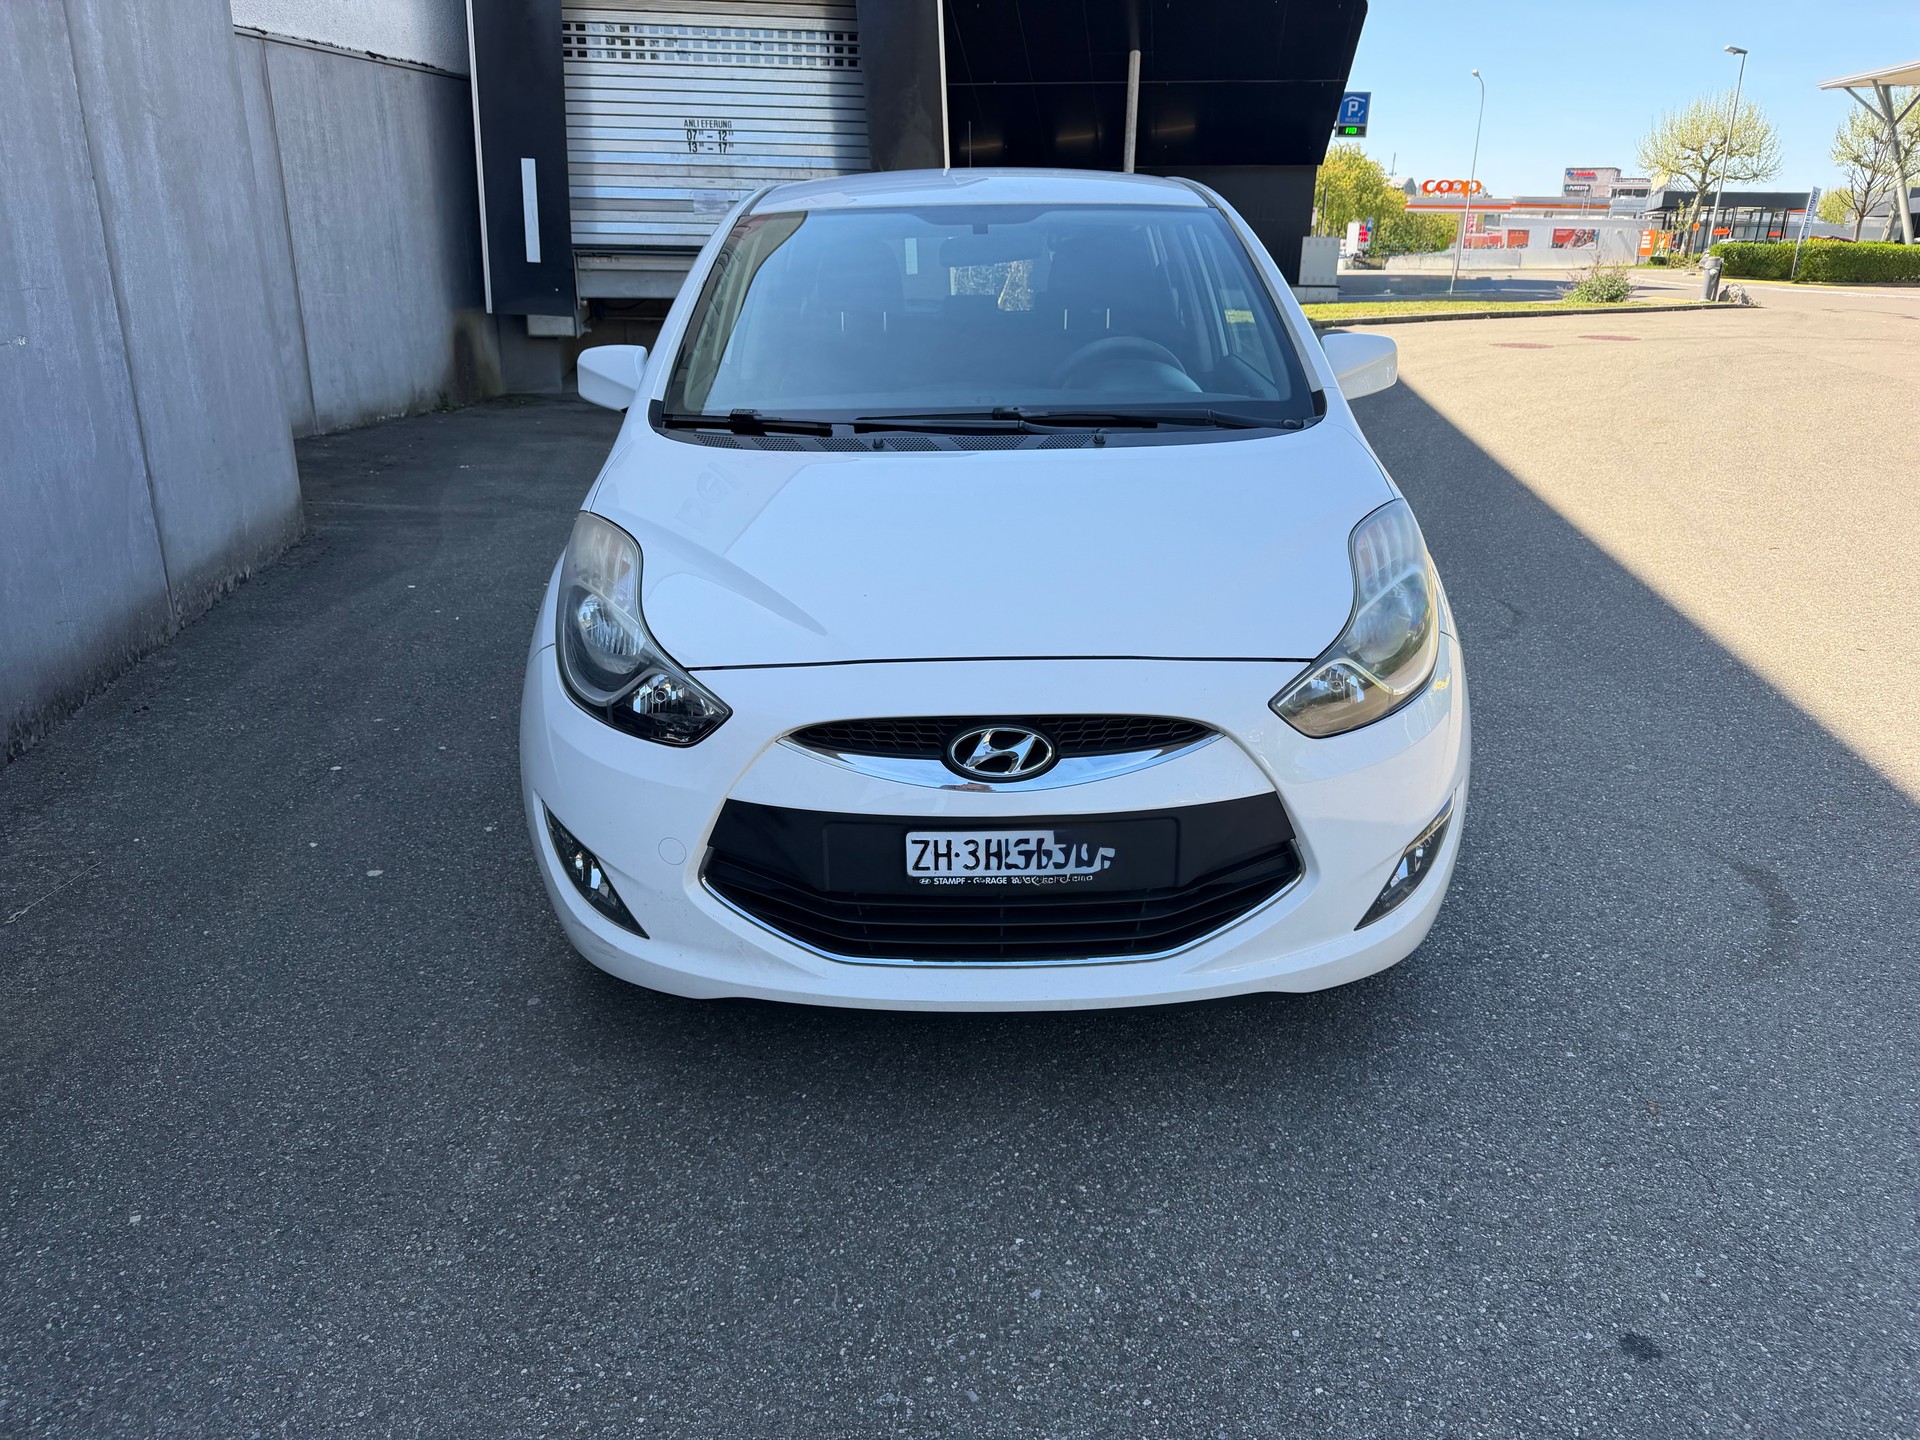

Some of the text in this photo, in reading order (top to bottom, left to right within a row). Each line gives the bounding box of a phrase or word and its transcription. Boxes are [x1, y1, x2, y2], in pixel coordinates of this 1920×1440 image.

[1347, 101, 1359, 117] P
[683, 119, 733, 128] ANLIEFERUNG
[1421, 179, 1482, 198] coop
[933, 877, 966, 885] STAMPF
